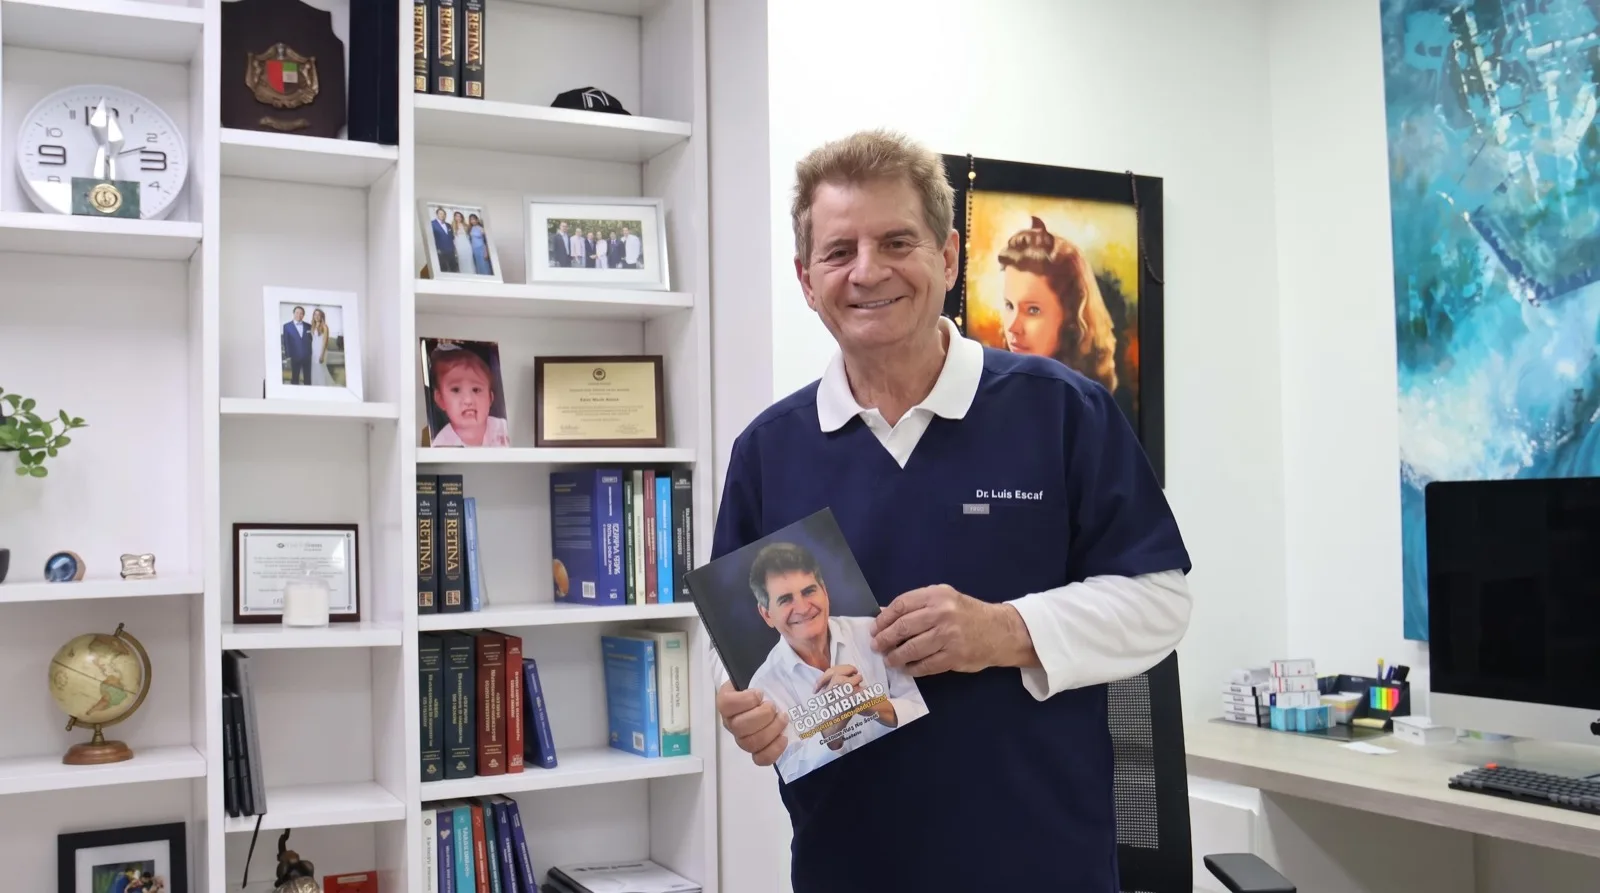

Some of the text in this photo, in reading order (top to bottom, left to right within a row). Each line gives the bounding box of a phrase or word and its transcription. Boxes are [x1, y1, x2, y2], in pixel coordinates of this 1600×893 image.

[414, 6, 424, 54] RETINA
[440, 7, 452, 57] RETINA
[468, 12, 479, 61] RETINA
[46, 127, 63, 138] 10
[146, 132, 158, 143] 2
[38, 144, 67, 166] 9
[140, 150, 167, 171] 3
[148, 181, 160, 191] 4
[976, 489, 1043, 500] Dr. Luis Escaf
[420, 519, 431, 572] RETINA
[447, 519, 458, 572] RETINA
[788, 705, 808, 721] EL
[807, 682, 854, 711] SUEÑO
[794, 683, 884, 732] COLOMBIANO
